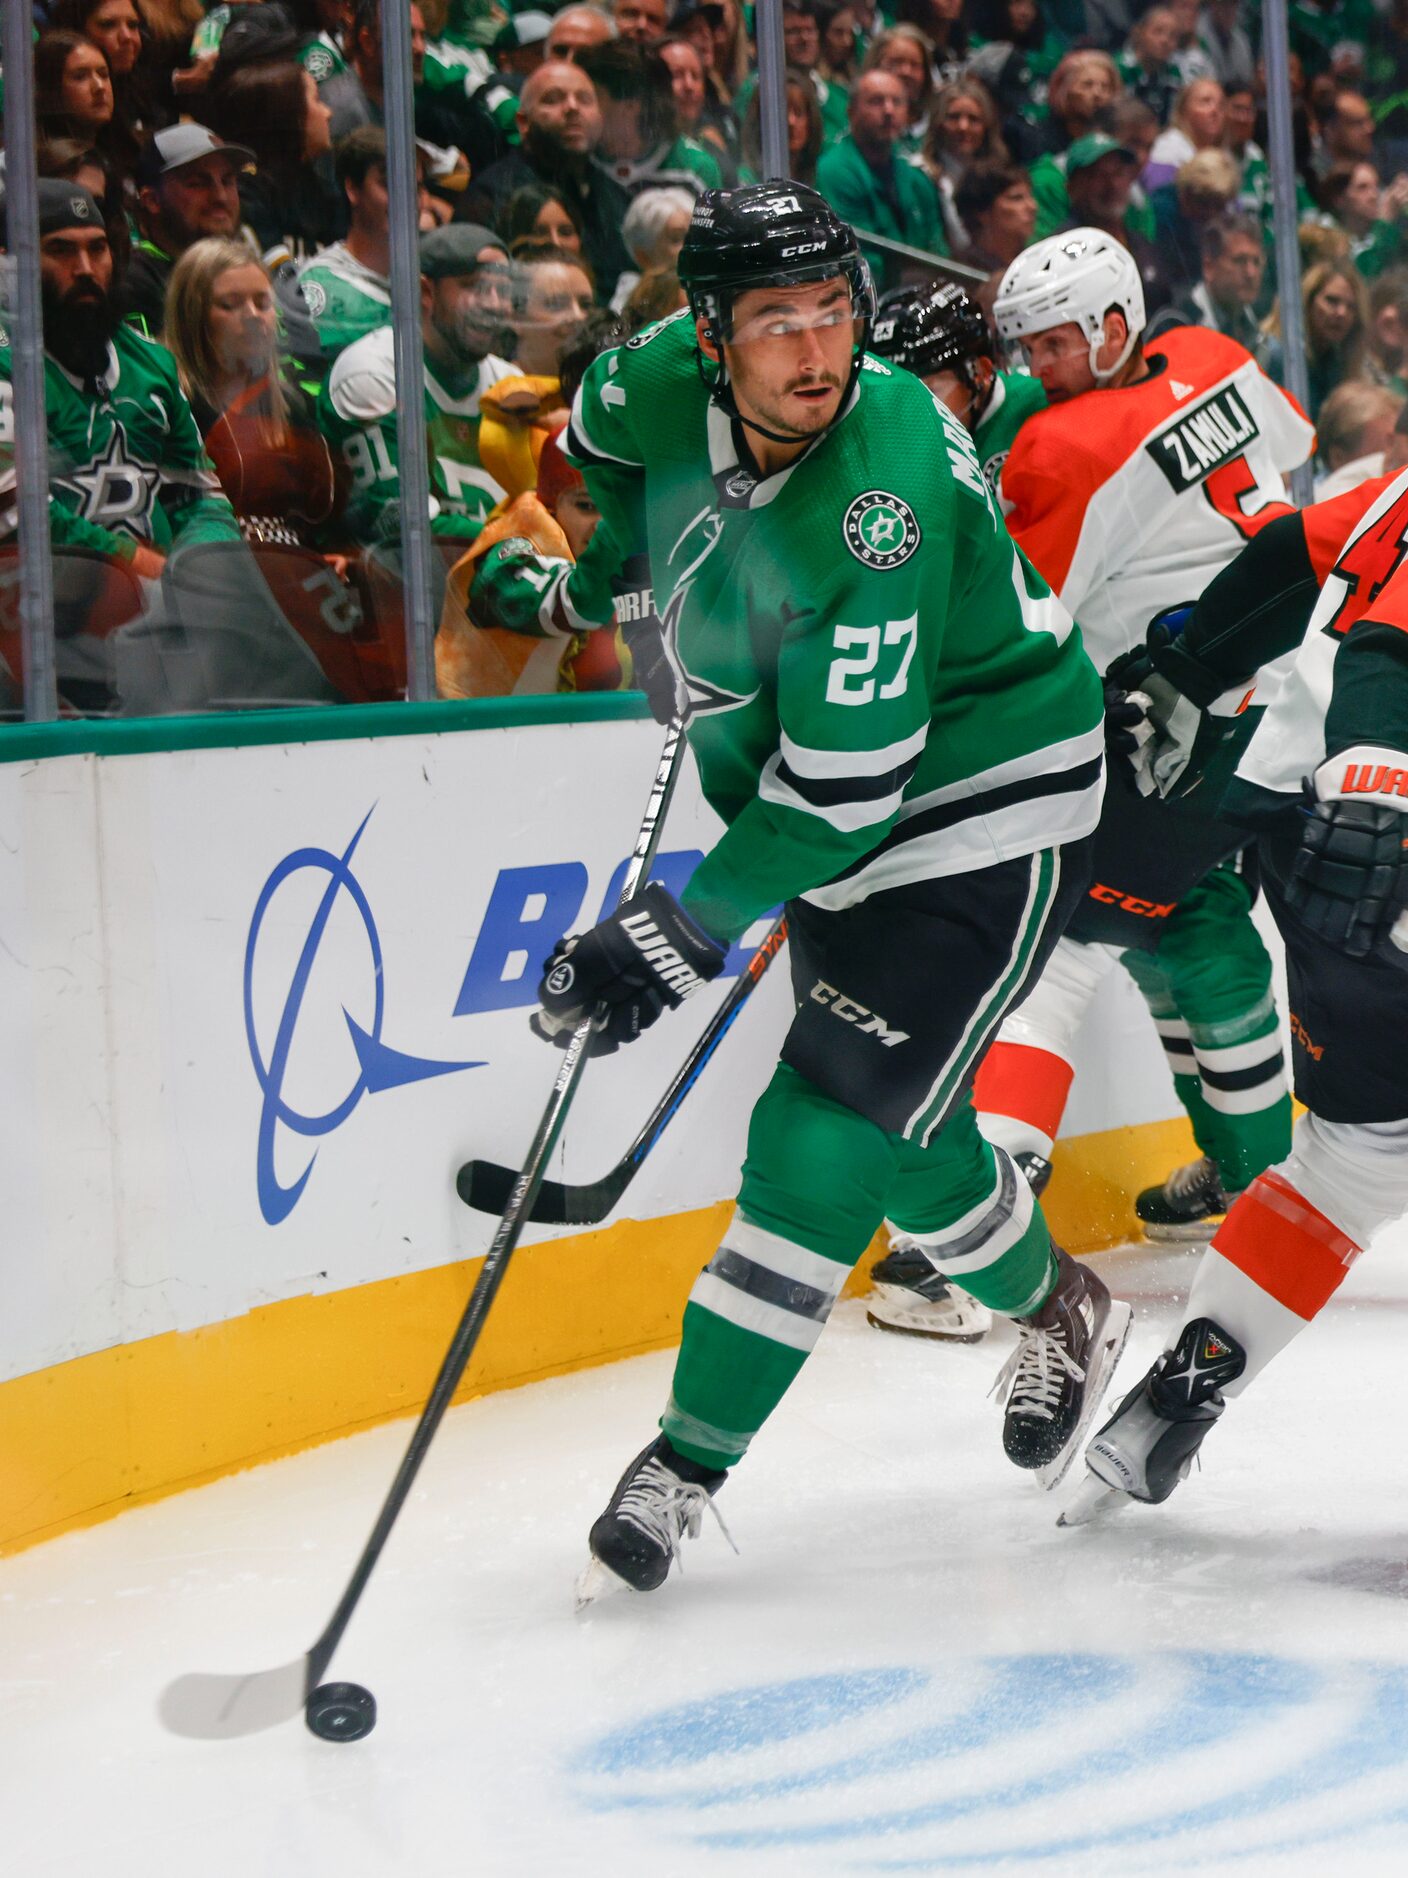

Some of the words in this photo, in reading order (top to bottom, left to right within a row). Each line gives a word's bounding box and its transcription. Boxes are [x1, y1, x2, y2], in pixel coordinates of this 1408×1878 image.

[766, 195, 802, 217] 27
[781, 241, 828, 258] CCM
[343, 424, 399, 489] 91
[848, 495, 908, 534] DALLAS
[861, 532, 917, 565] STARS
[825, 608, 919, 706] 27
[810, 978, 912, 1048] CCM
